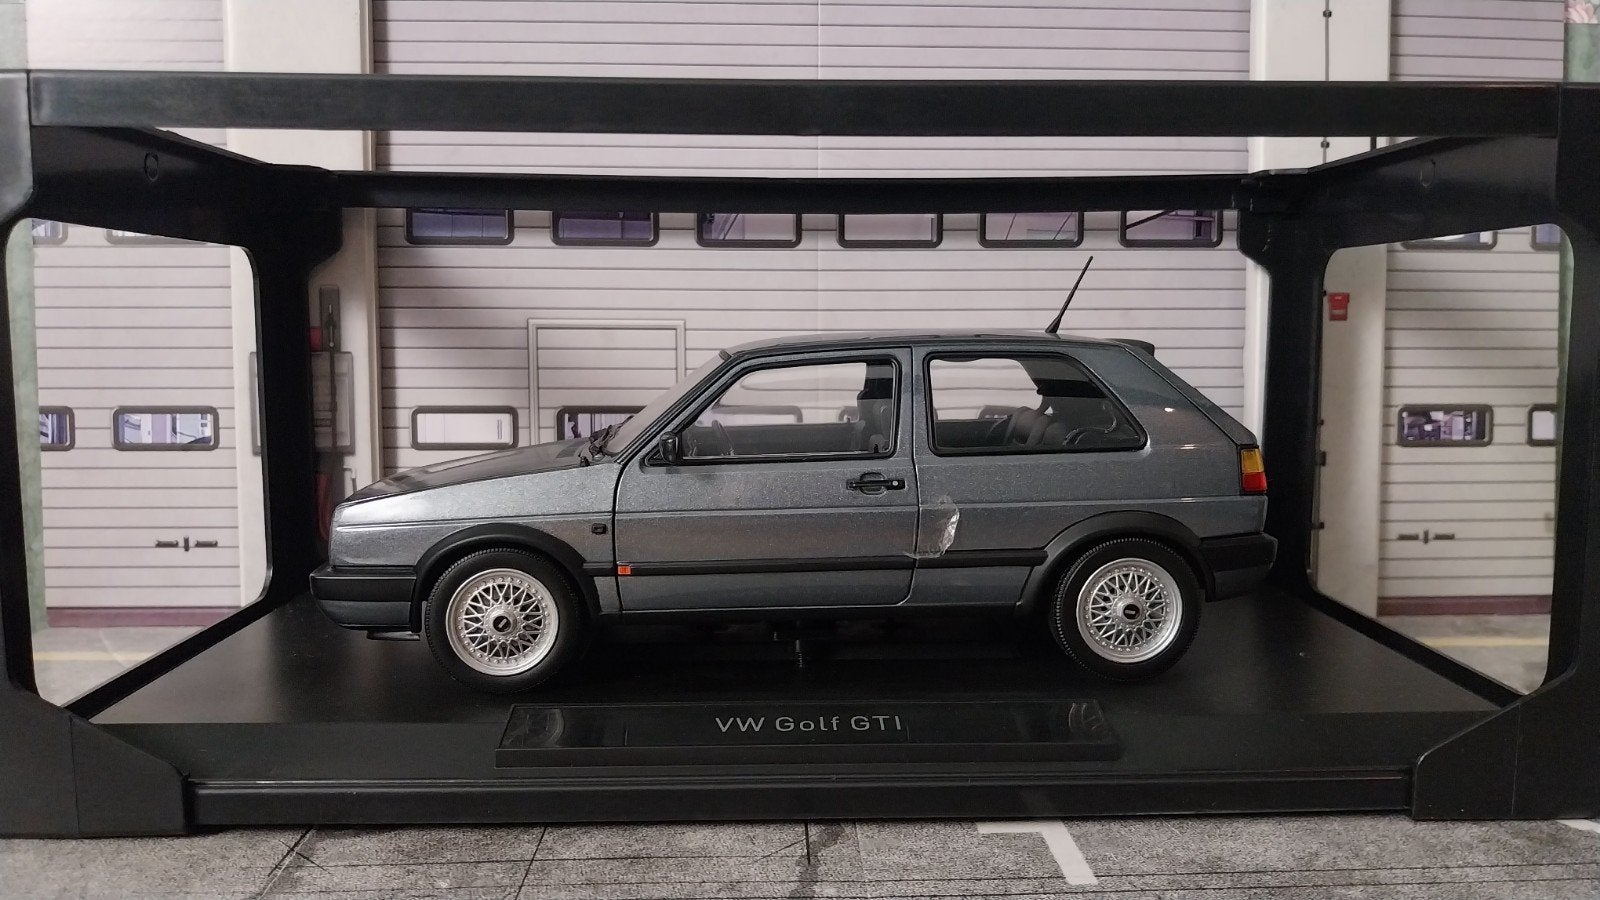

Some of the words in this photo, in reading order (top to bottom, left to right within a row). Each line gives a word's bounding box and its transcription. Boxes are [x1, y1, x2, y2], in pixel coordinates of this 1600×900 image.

[715, 717, 765, 732] VW
[775, 716, 840, 732] Golf
[850, 715, 901, 731] GTI
